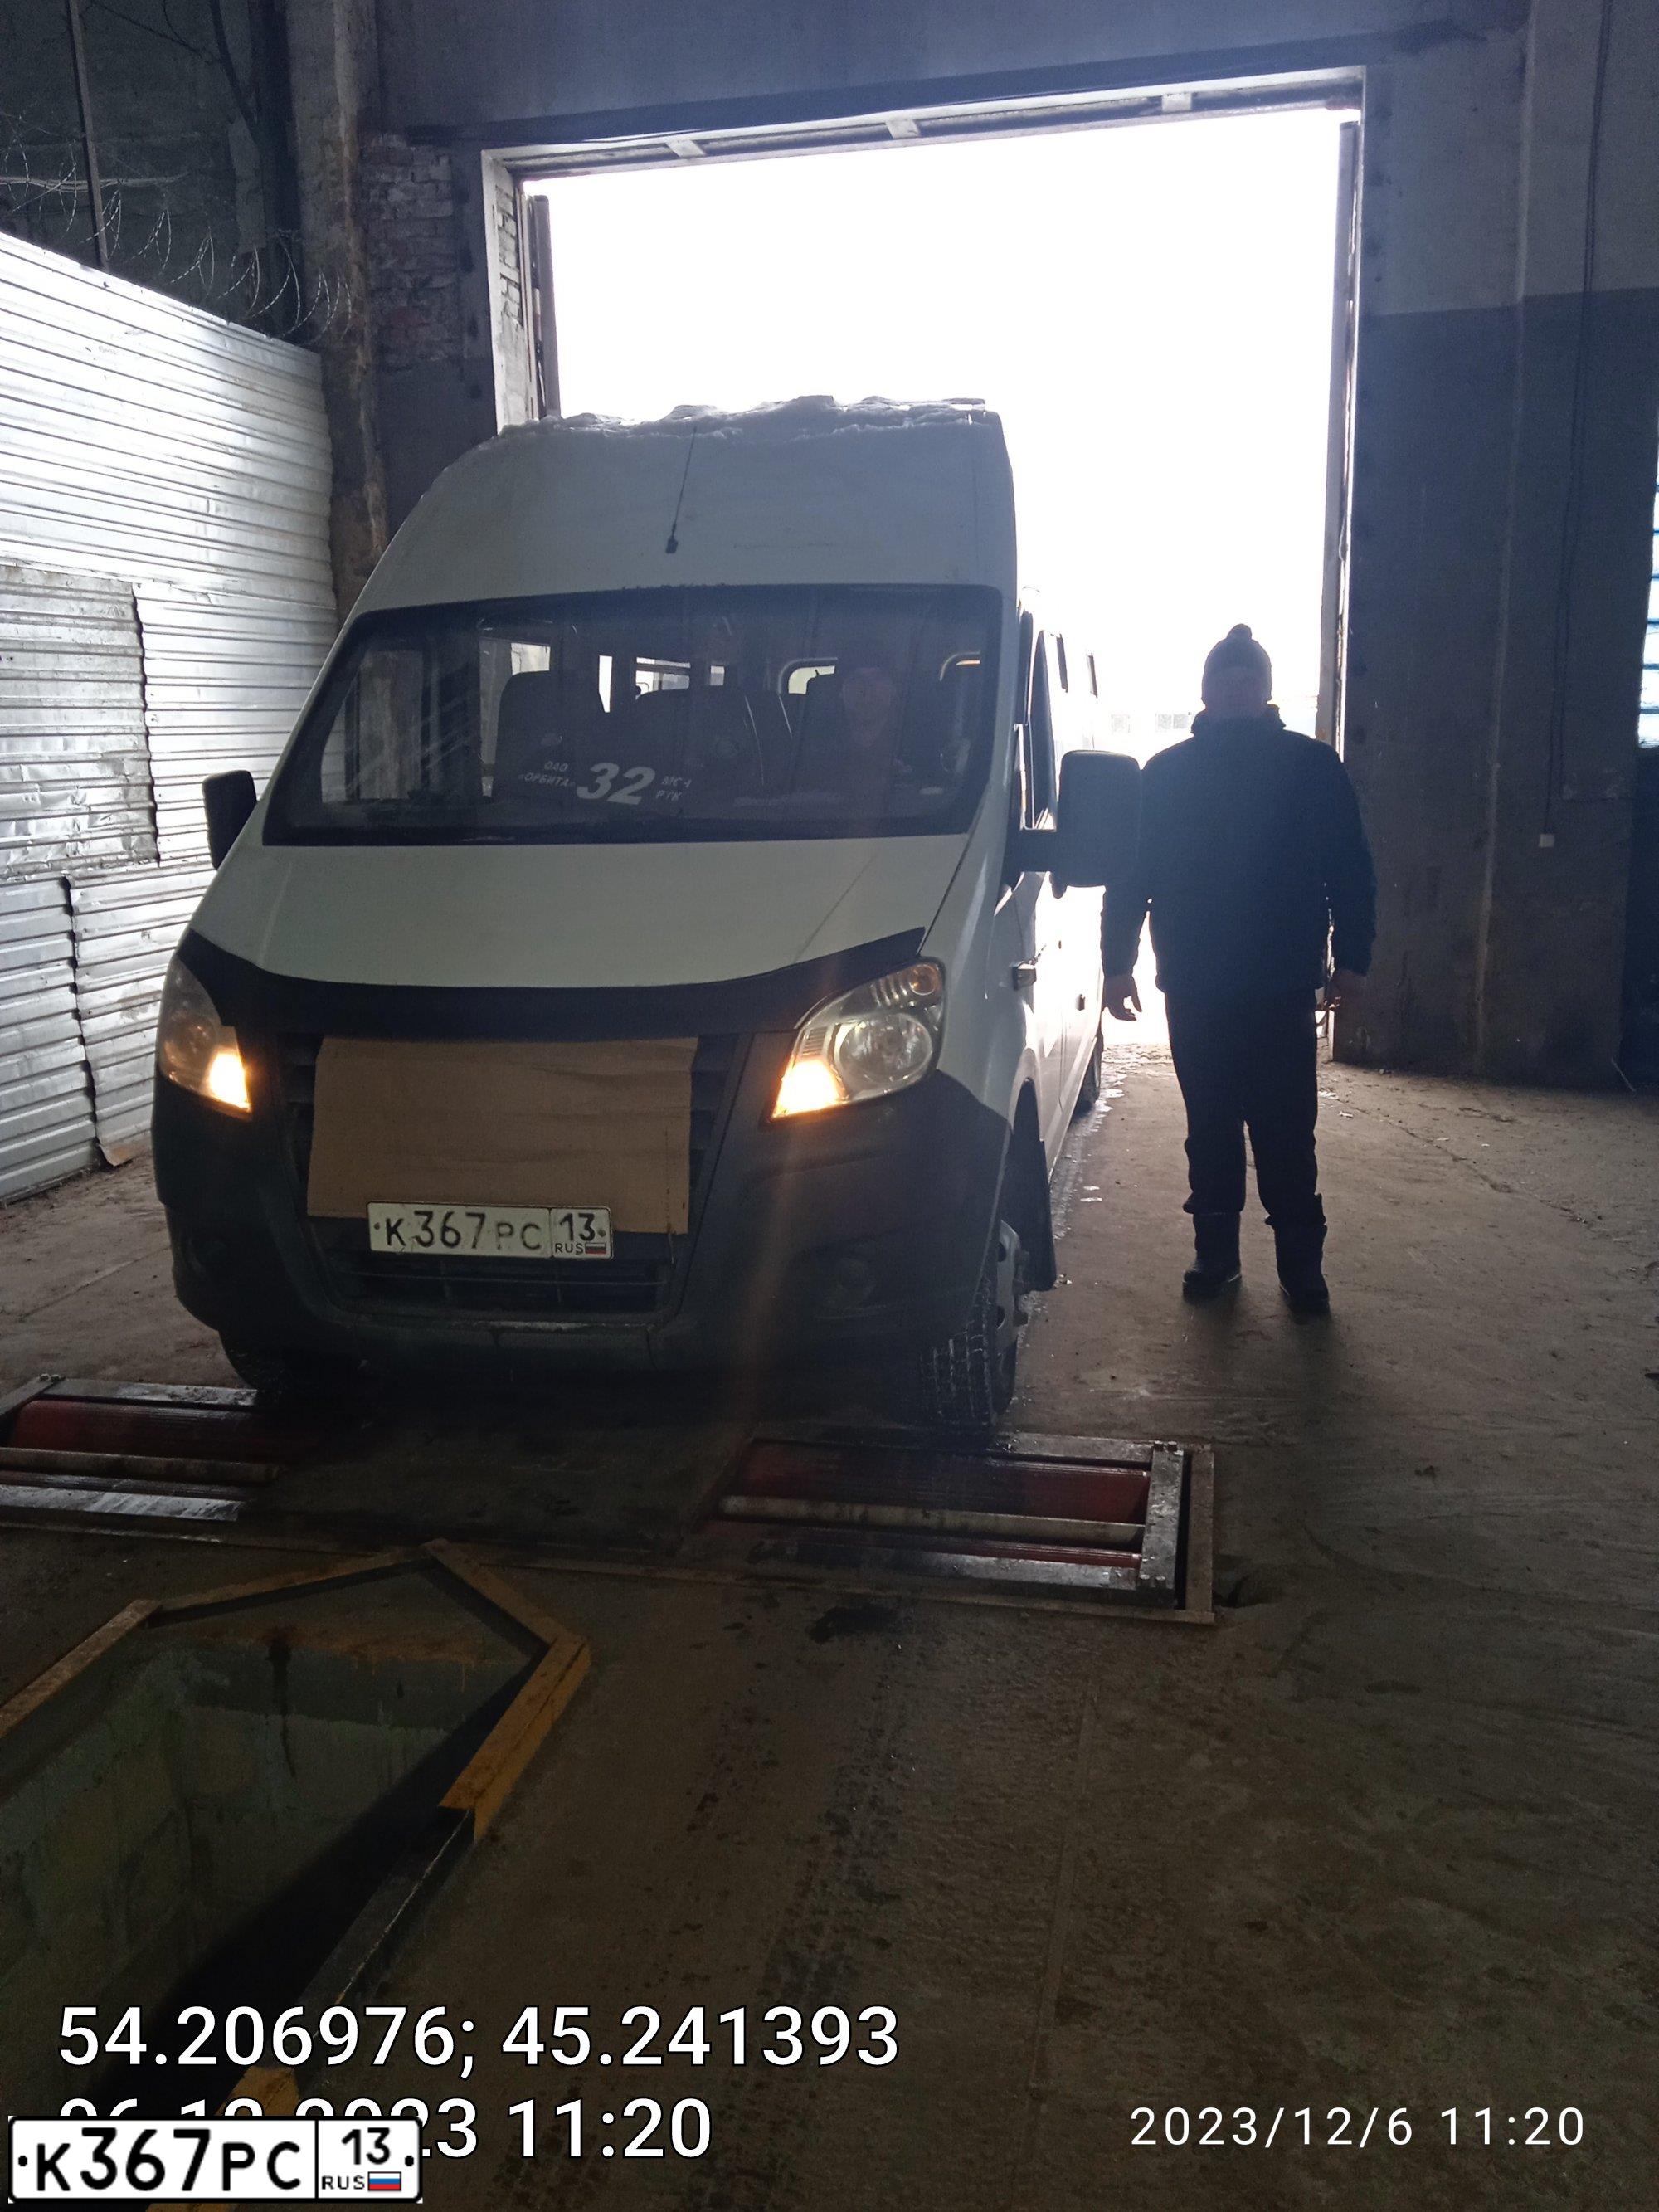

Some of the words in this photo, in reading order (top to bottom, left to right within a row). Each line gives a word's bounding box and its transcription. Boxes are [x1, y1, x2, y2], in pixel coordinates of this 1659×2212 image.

[577, 762, 655, 805] 32
[385, 1210, 543, 1250] К367РС
[559, 1212, 596, 1242] 13
[554, 1242, 585, 1255] RUS
